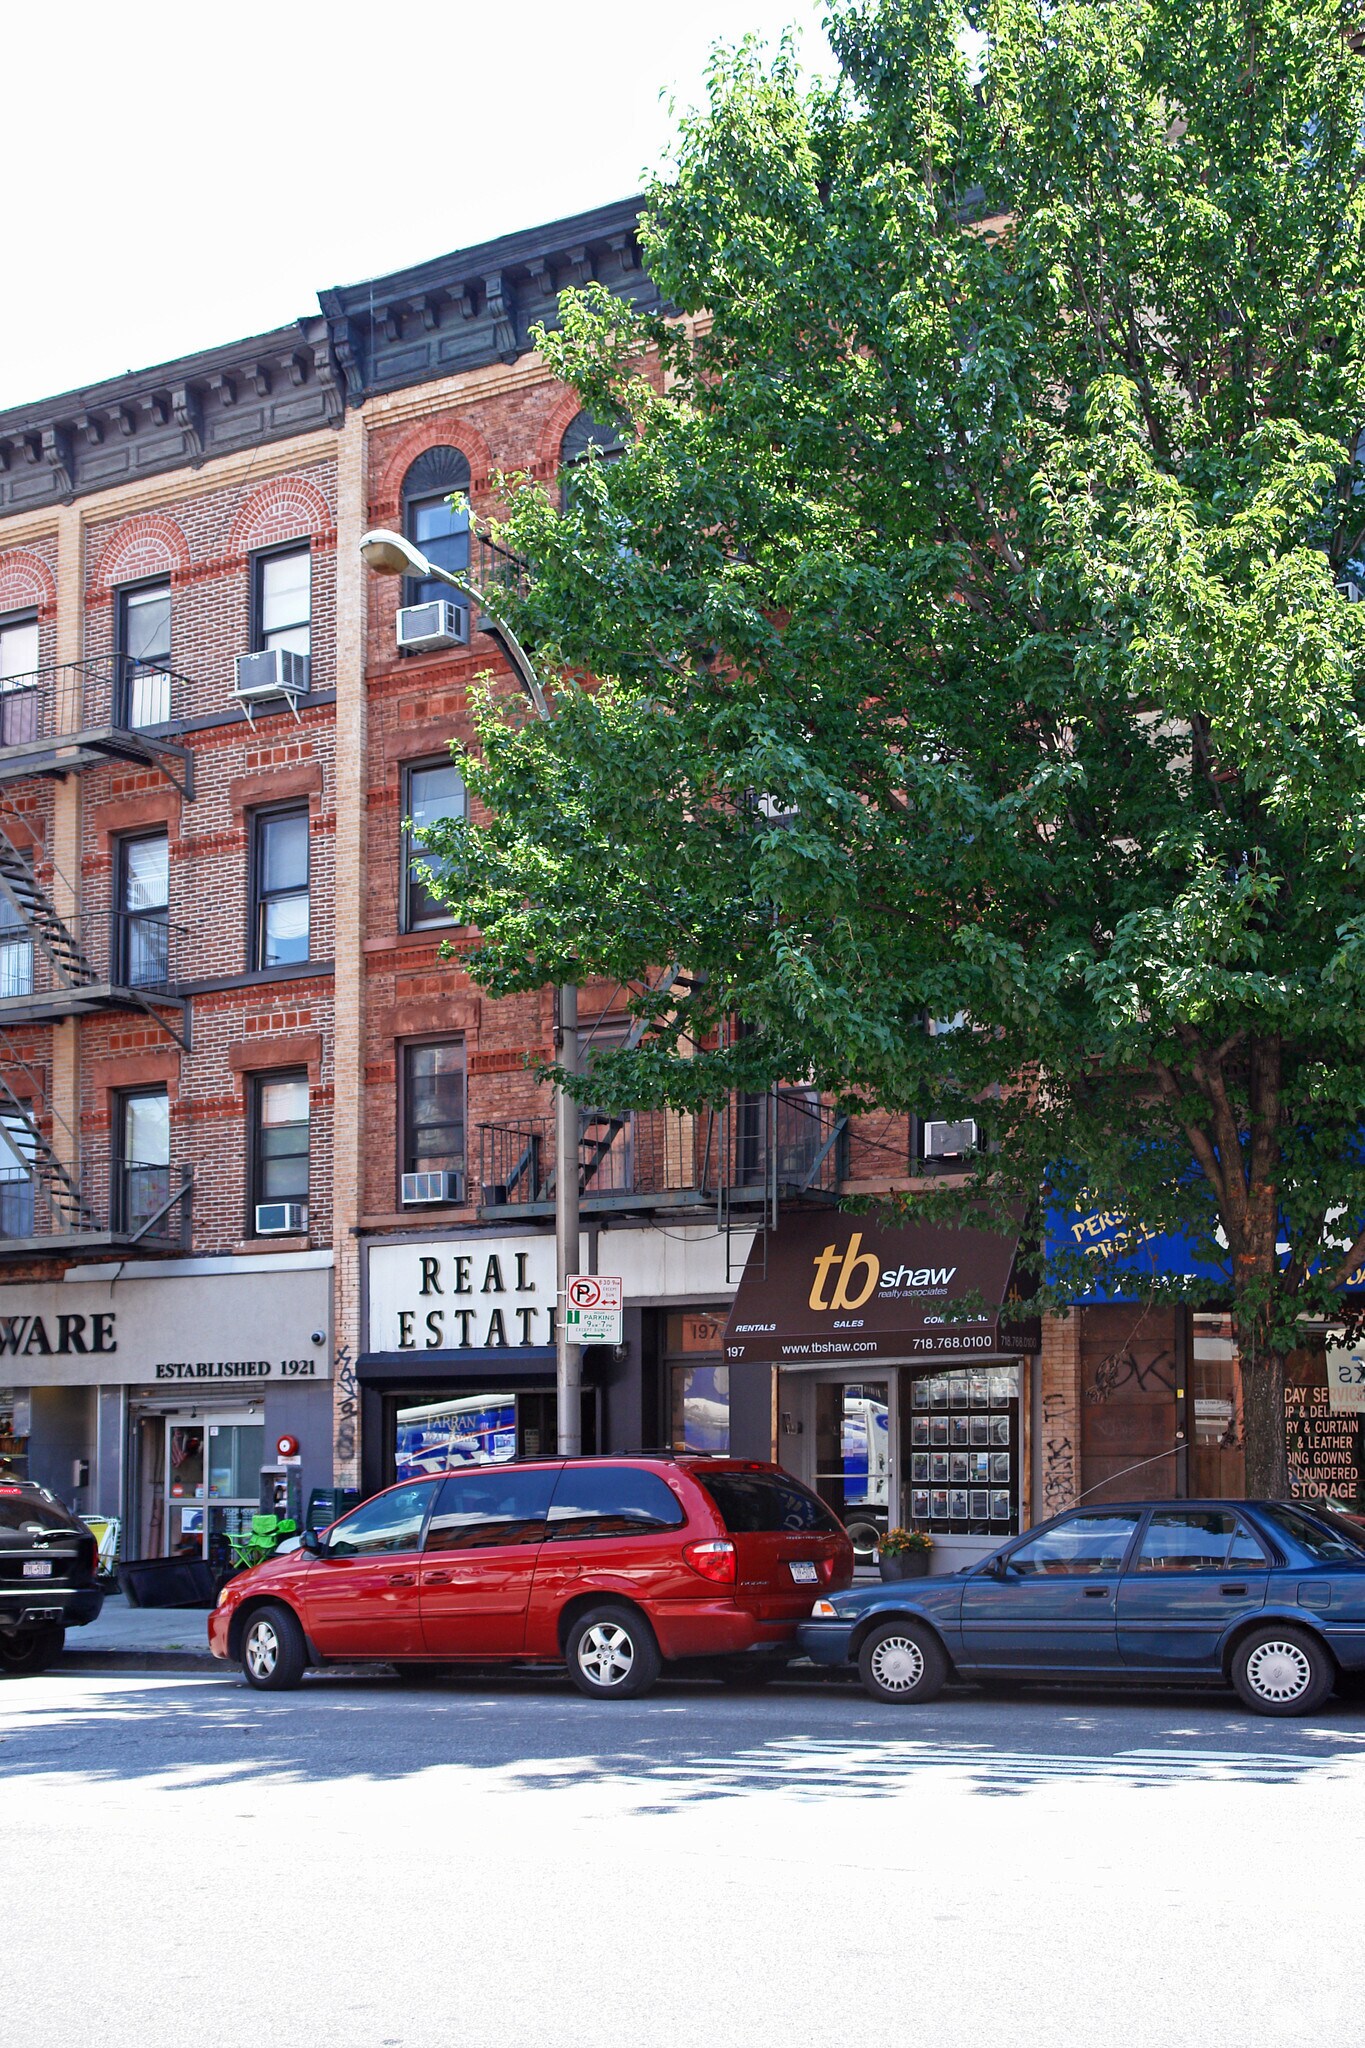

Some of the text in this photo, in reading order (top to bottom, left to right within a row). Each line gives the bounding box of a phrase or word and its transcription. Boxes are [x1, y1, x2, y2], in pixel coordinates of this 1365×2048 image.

[419, 1253, 536, 1295] REAL
[809, 1232, 957, 1310] tb shaw
[878, 1287, 948, 1299] realty associates
[692, 1323, 718, 1340] 197
[735, 1314, 989, 1333] RENTALS SALES COMECAL
[0, 1312, 117, 1356] WARE
[726, 1346, 745, 1357] 197
[781, 1339, 878, 1355] www.tbshaw.com
[912, 1335, 992, 1349] 718.768.0100
[155, 1360, 316, 1379] ESTABLISHED 1921
[1284, 1387, 1307, 1404] DAY
[1299, 1405, 1306, 1419] &
[1310, 1405, 1358, 1419] DELIVERY
[426, 1413, 476, 1431] FARRAN
[1303, 1421, 1311, 1434] &
[1315, 1421, 1359, 1434] CURTAIN
[1297, 1436, 1304, 1449] &
[1308, 1436, 1353, 1449] LEATHER
[1313, 1451, 1352, 1465] GOWNS
[1297, 1467, 1358, 1480] LAUNDERED
[1291, 1482, 1357, 1498] STORAGE
